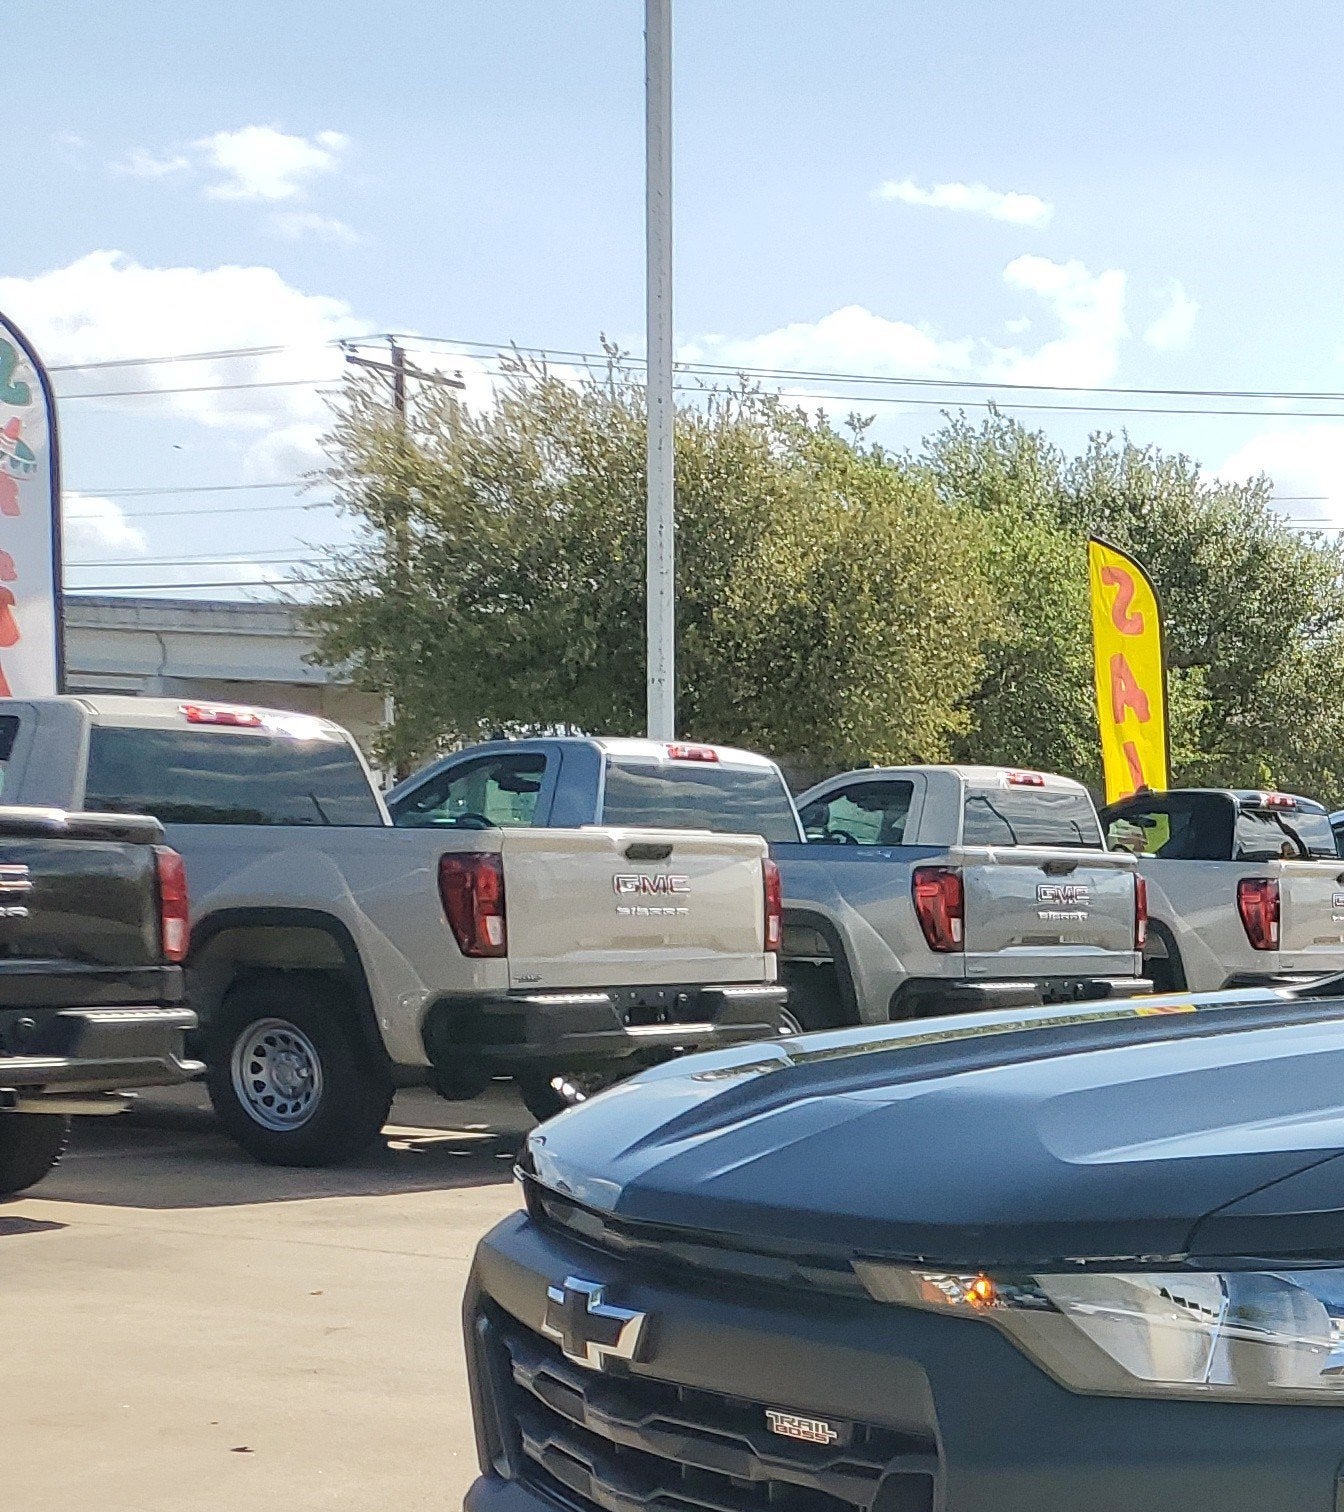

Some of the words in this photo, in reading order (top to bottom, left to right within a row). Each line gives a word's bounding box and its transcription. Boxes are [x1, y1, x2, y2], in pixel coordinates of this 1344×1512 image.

[614, 874, 692, 896] GMC
[1036, 884, 1090, 904] GMC
[765, 1410, 838, 1440] TRAIL
[774, 1424, 830, 1445] BOSS
